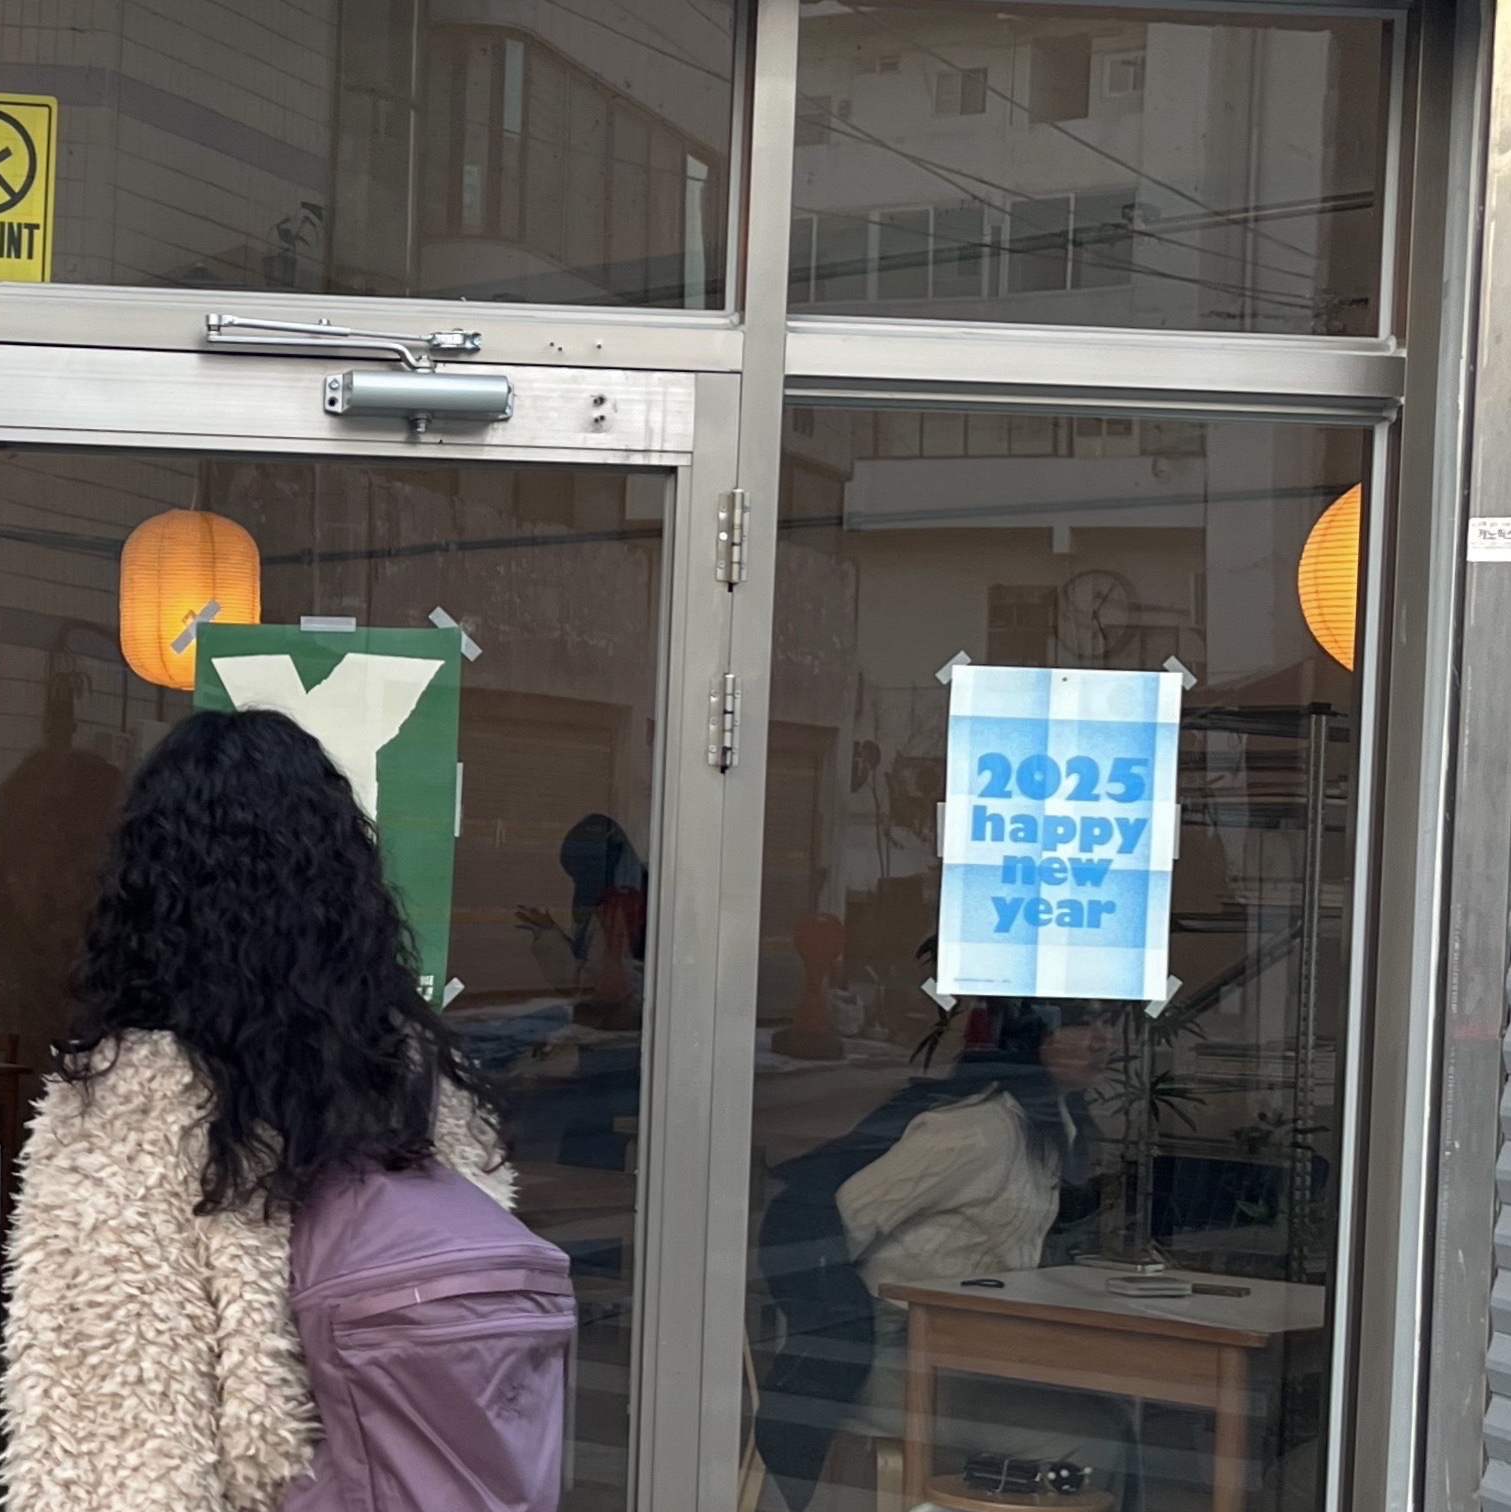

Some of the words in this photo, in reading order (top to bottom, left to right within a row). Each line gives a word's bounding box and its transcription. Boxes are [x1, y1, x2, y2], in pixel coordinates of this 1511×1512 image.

[976, 752, 1150, 804] 2025
[971, 805, 1149, 855] happy
[1001, 855, 1114, 888] new
[990, 896, 1117, 933] year
